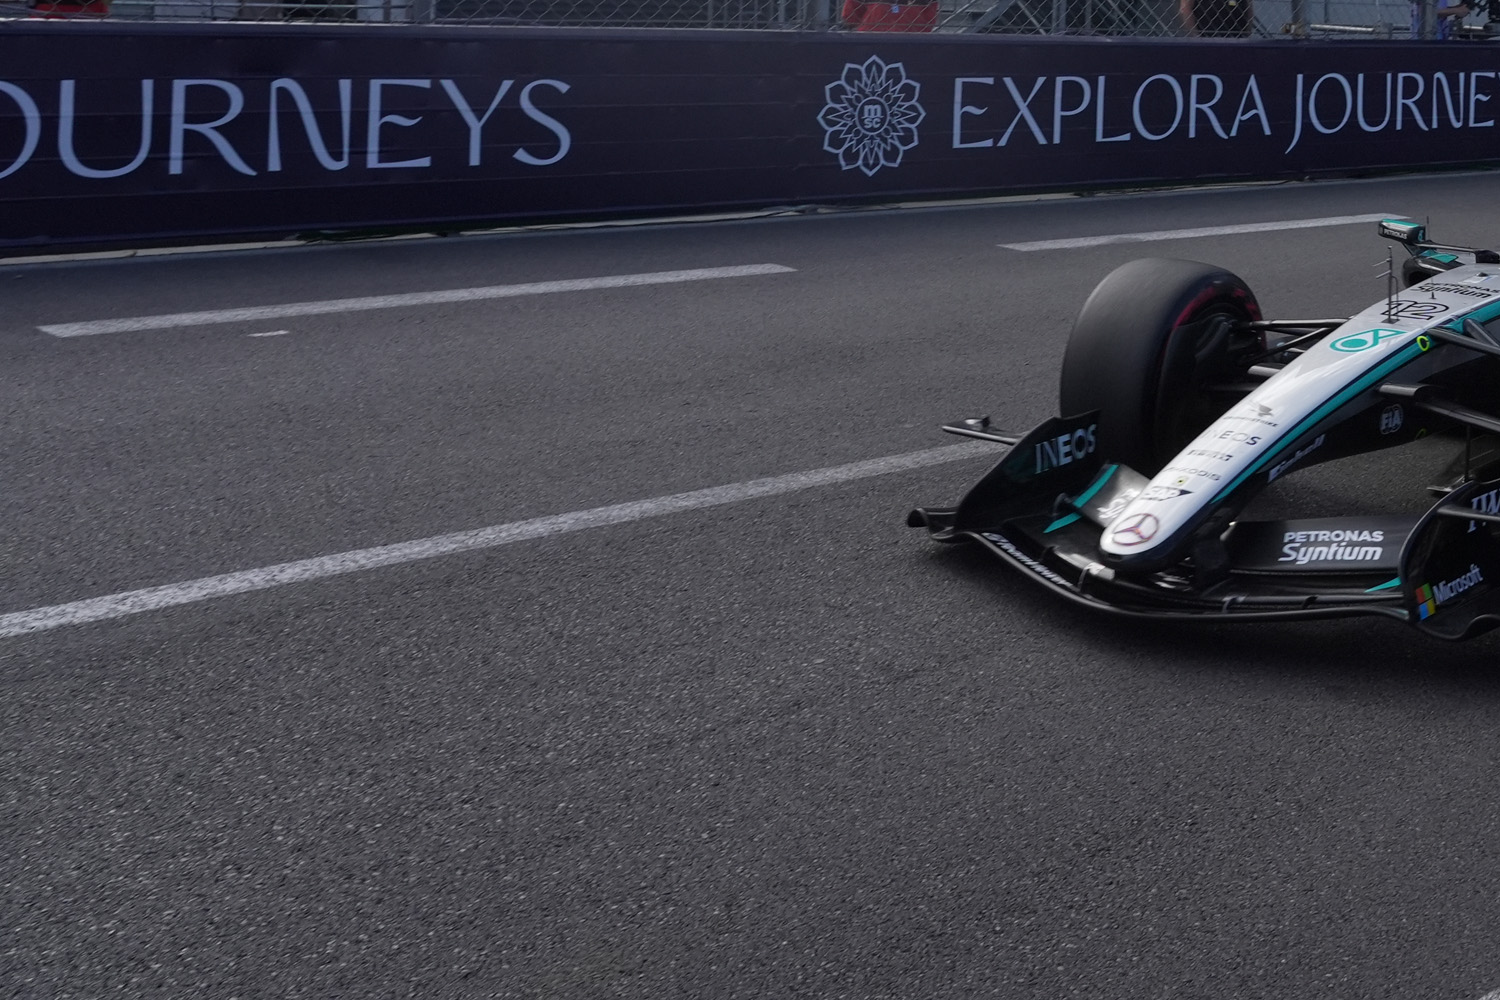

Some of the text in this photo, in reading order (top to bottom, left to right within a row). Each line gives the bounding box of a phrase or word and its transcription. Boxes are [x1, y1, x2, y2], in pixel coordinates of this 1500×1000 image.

[952, 73, 1272, 149] EXPLORA
[1383, 228, 1408, 240] PETRONAS
[1035, 424, 1097, 474] INEOS
[1278, 541, 1383, 565] Syntium
[1283, 530, 1384, 543] PETRONAS
[1432, 564, 1483, 606] Microsoft
